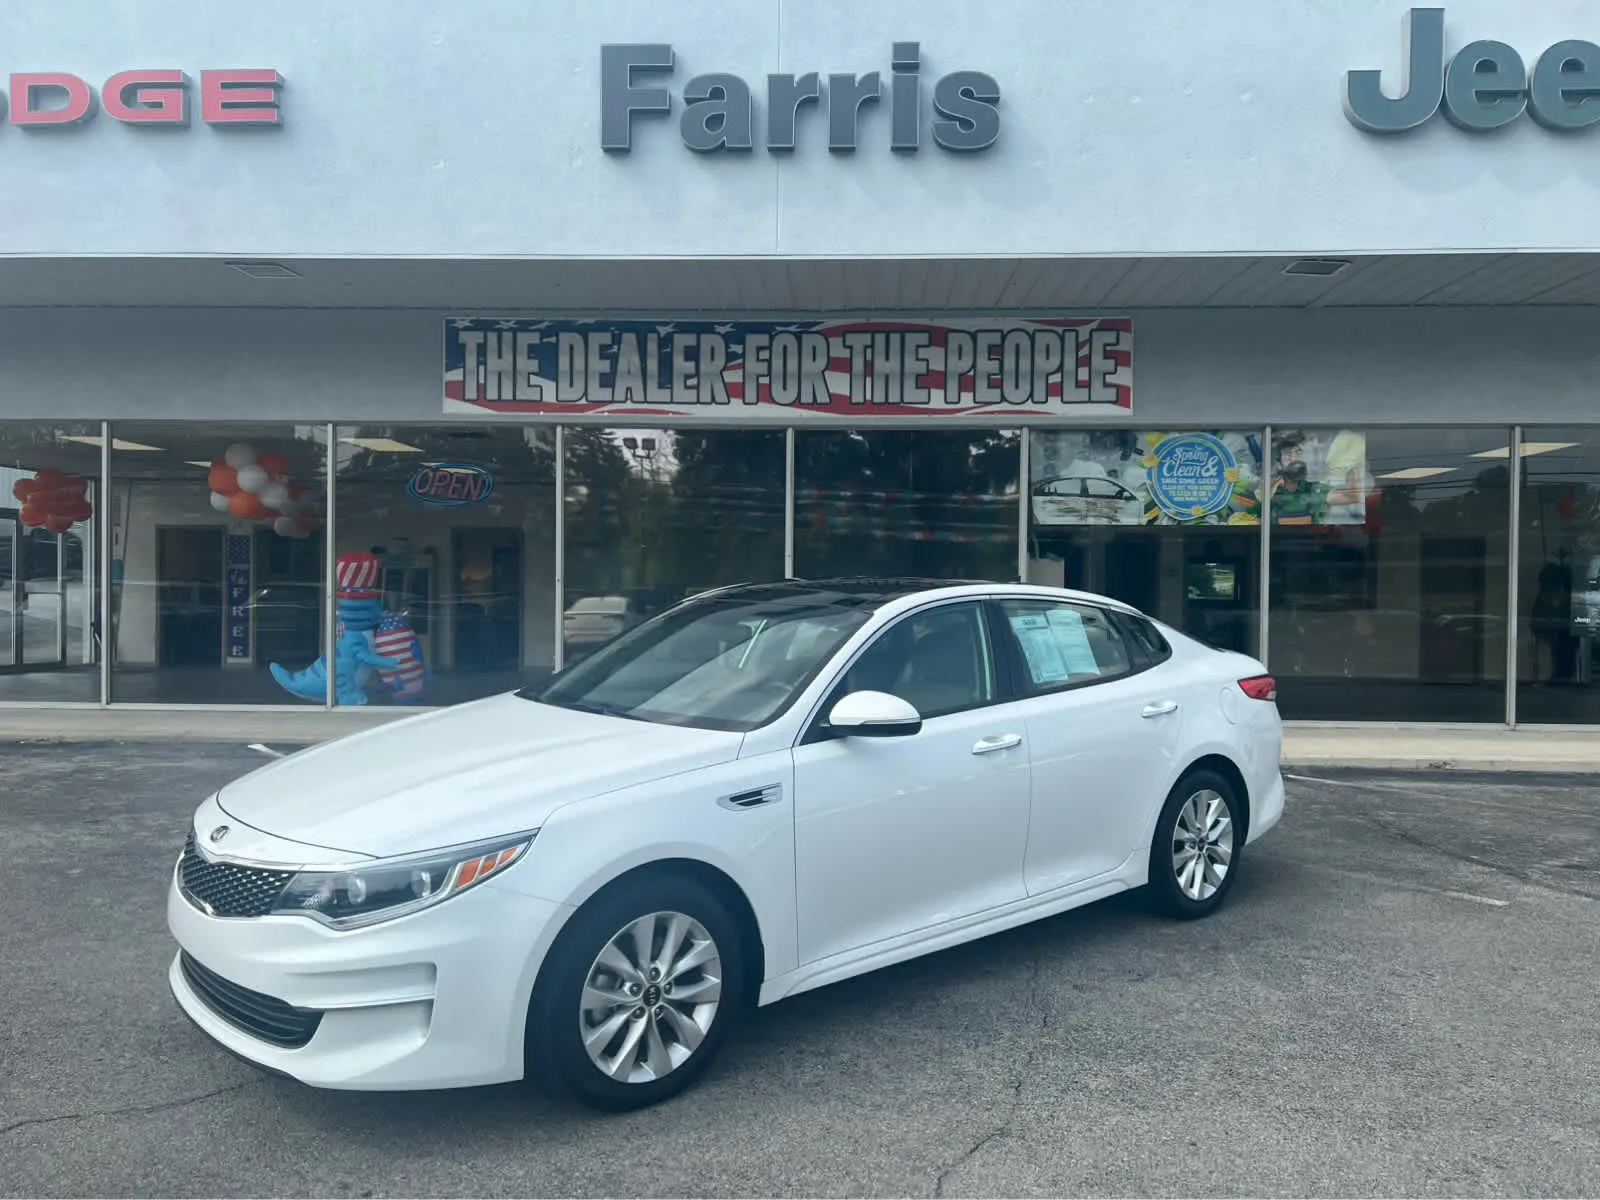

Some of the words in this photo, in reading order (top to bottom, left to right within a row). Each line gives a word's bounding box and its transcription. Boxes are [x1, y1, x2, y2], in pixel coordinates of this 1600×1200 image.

[0, 69, 282, 129] DGE
[600, 42, 1001, 152] Farris
[459, 331, 543, 402] THE
[556, 331, 730, 404] DEALER
[742, 331, 831, 405] FOR
[843, 330, 931, 404] THE
[945, 329, 1119, 404] PEOPLE
[415, 469, 484, 501] OPEN
[1163, 459, 1200, 476] Clean
[1201, 456, 1218, 476] &
[231, 587, 244, 656] FREE
